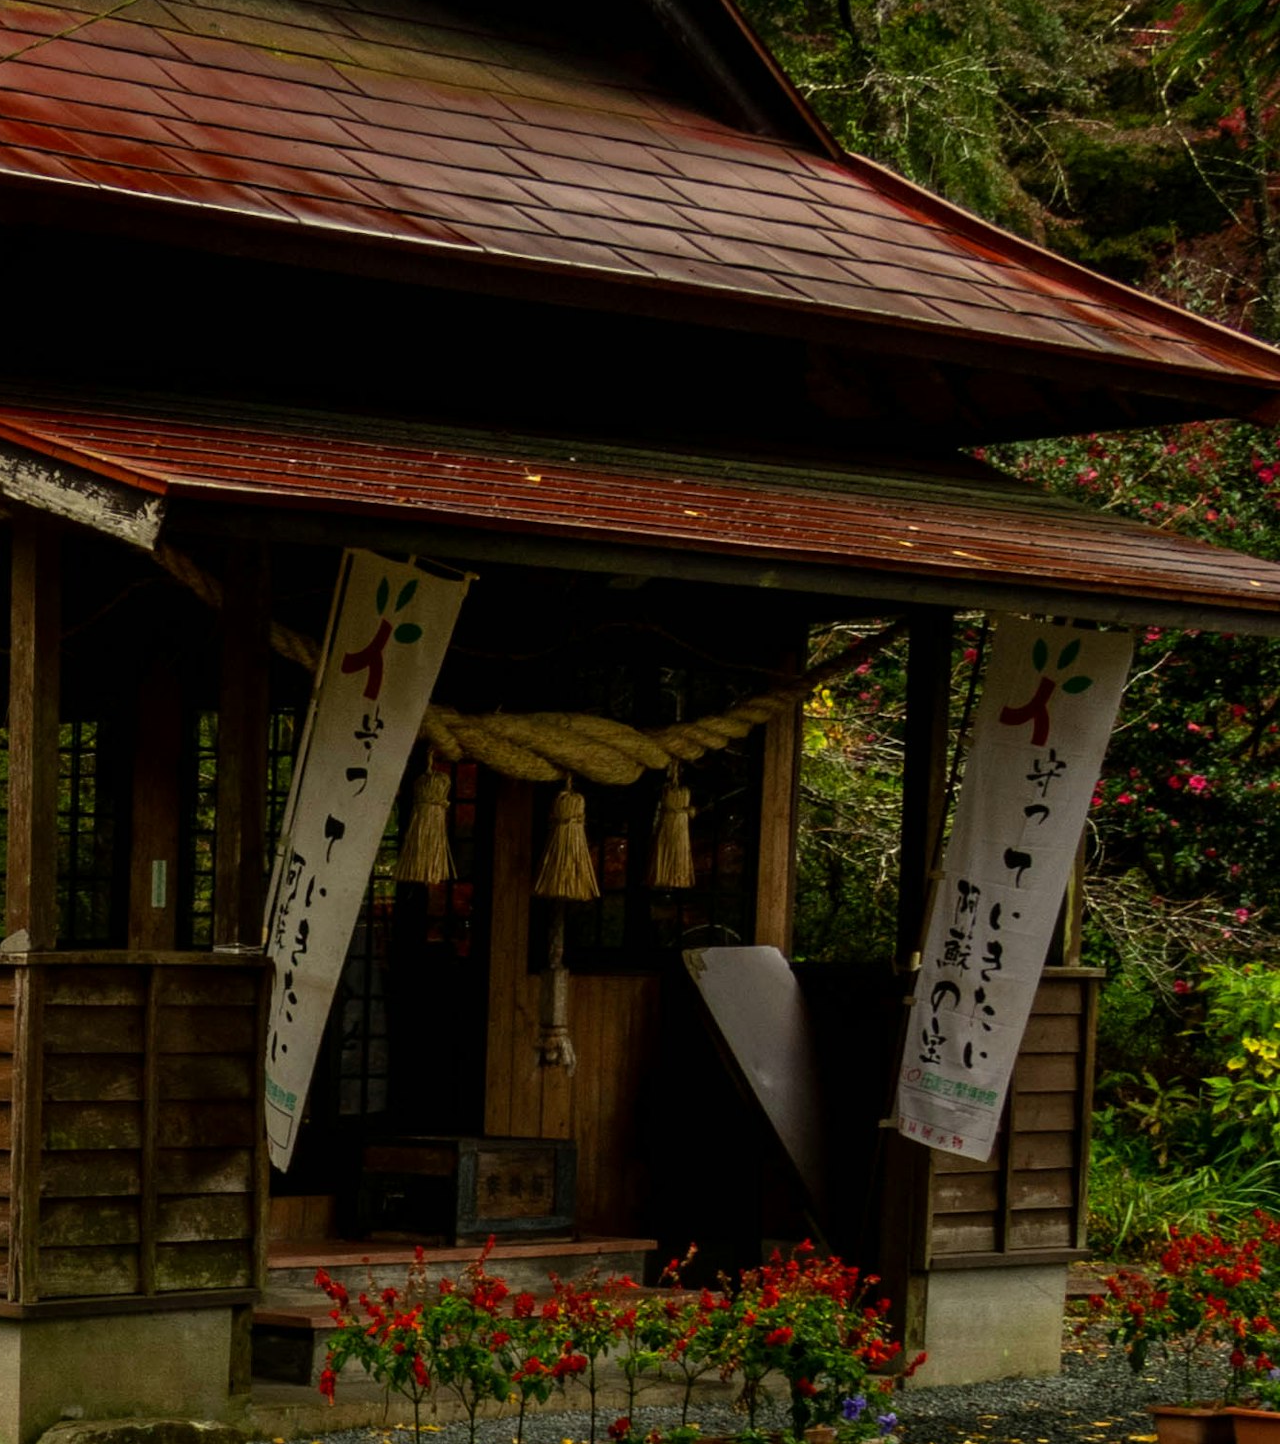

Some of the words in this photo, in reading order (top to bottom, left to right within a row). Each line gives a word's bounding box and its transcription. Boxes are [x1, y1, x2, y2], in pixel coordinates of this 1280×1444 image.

[918, 879, 981, 1065] 阿蘇の宝
[962, 749, 1066, 1069] 守っていきたい
